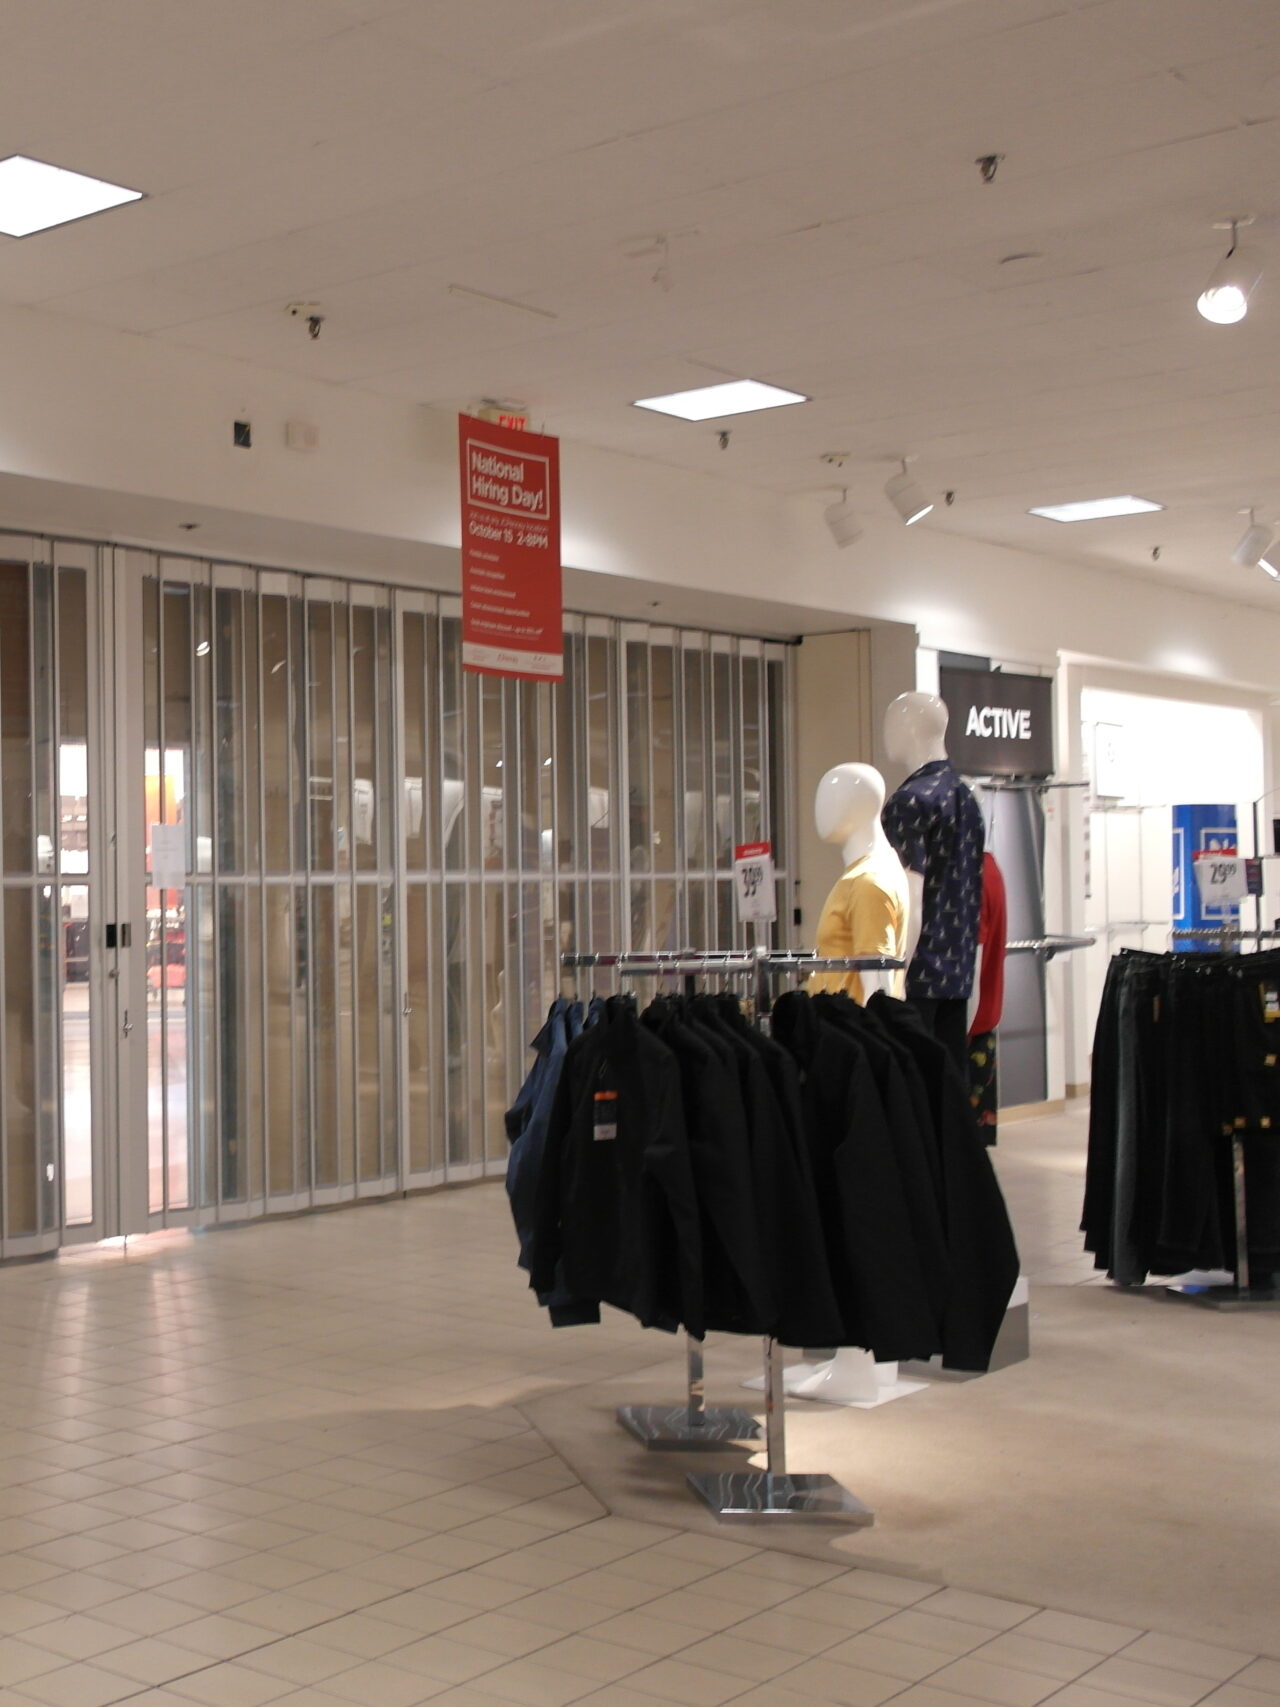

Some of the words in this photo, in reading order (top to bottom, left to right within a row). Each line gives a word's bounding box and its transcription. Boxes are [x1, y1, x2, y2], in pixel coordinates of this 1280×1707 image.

[471, 451, 524, 483] National
[471, 475, 510, 506] Hiring
[511, 485, 544, 512] Day!
[468, 520, 502, 542] October
[965, 705, 1032, 740] ACTIVE
